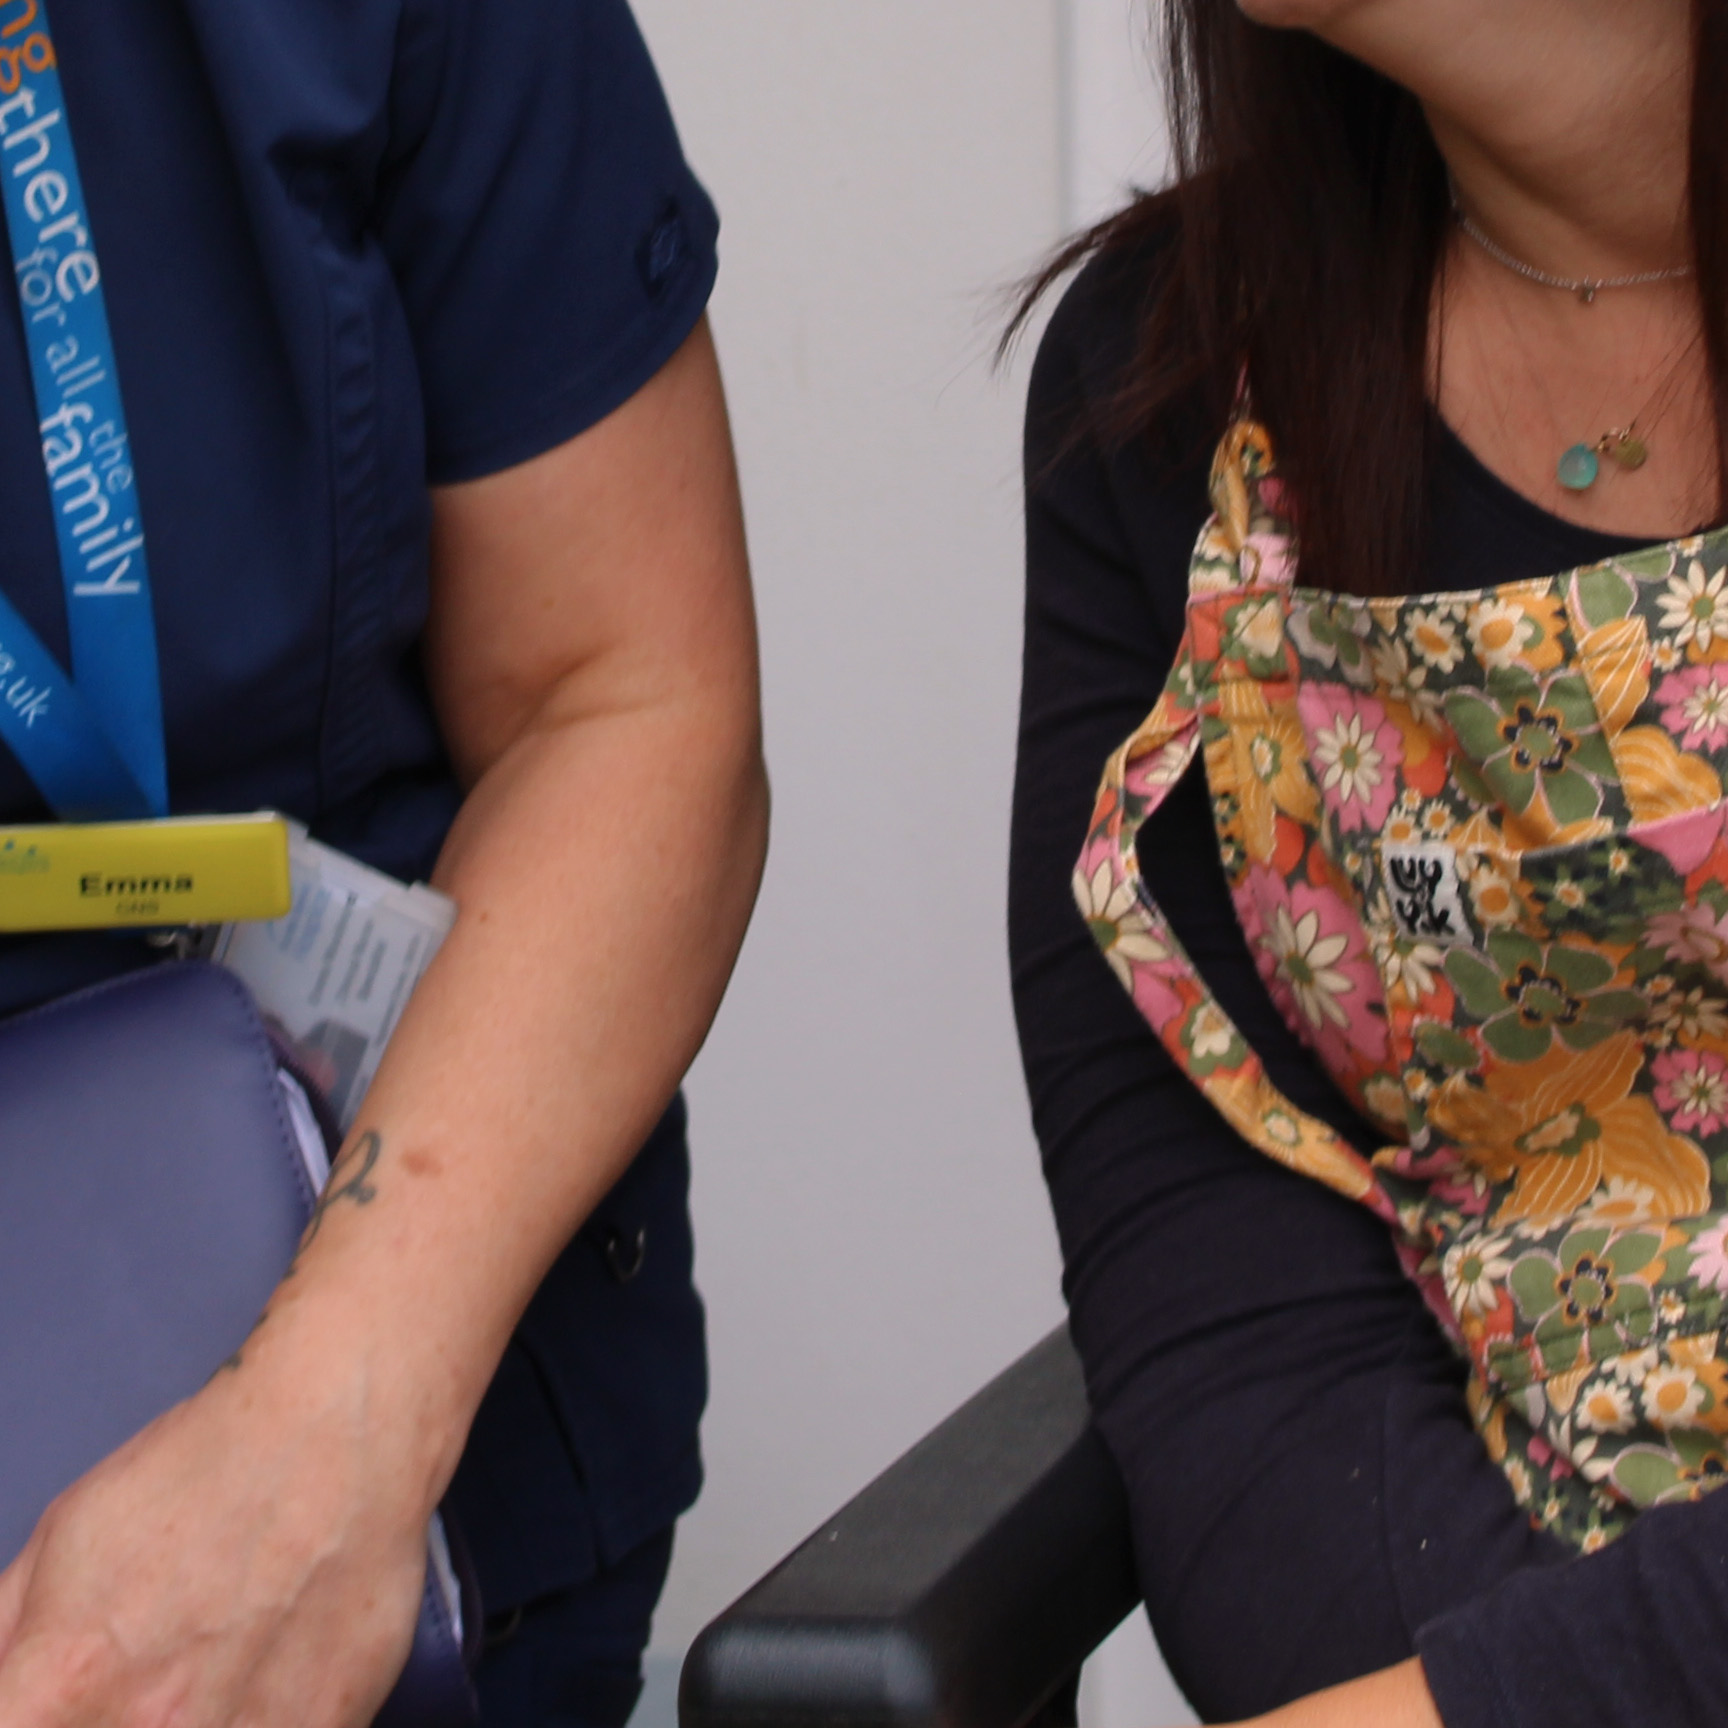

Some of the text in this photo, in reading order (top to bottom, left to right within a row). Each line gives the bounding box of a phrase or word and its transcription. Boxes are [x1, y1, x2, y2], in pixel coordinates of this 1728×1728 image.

[15, 247, 106, 399] for all
[39, 401, 144, 597] family
[88, 419, 133, 495] the
[79, 872, 194, 897] Emma
